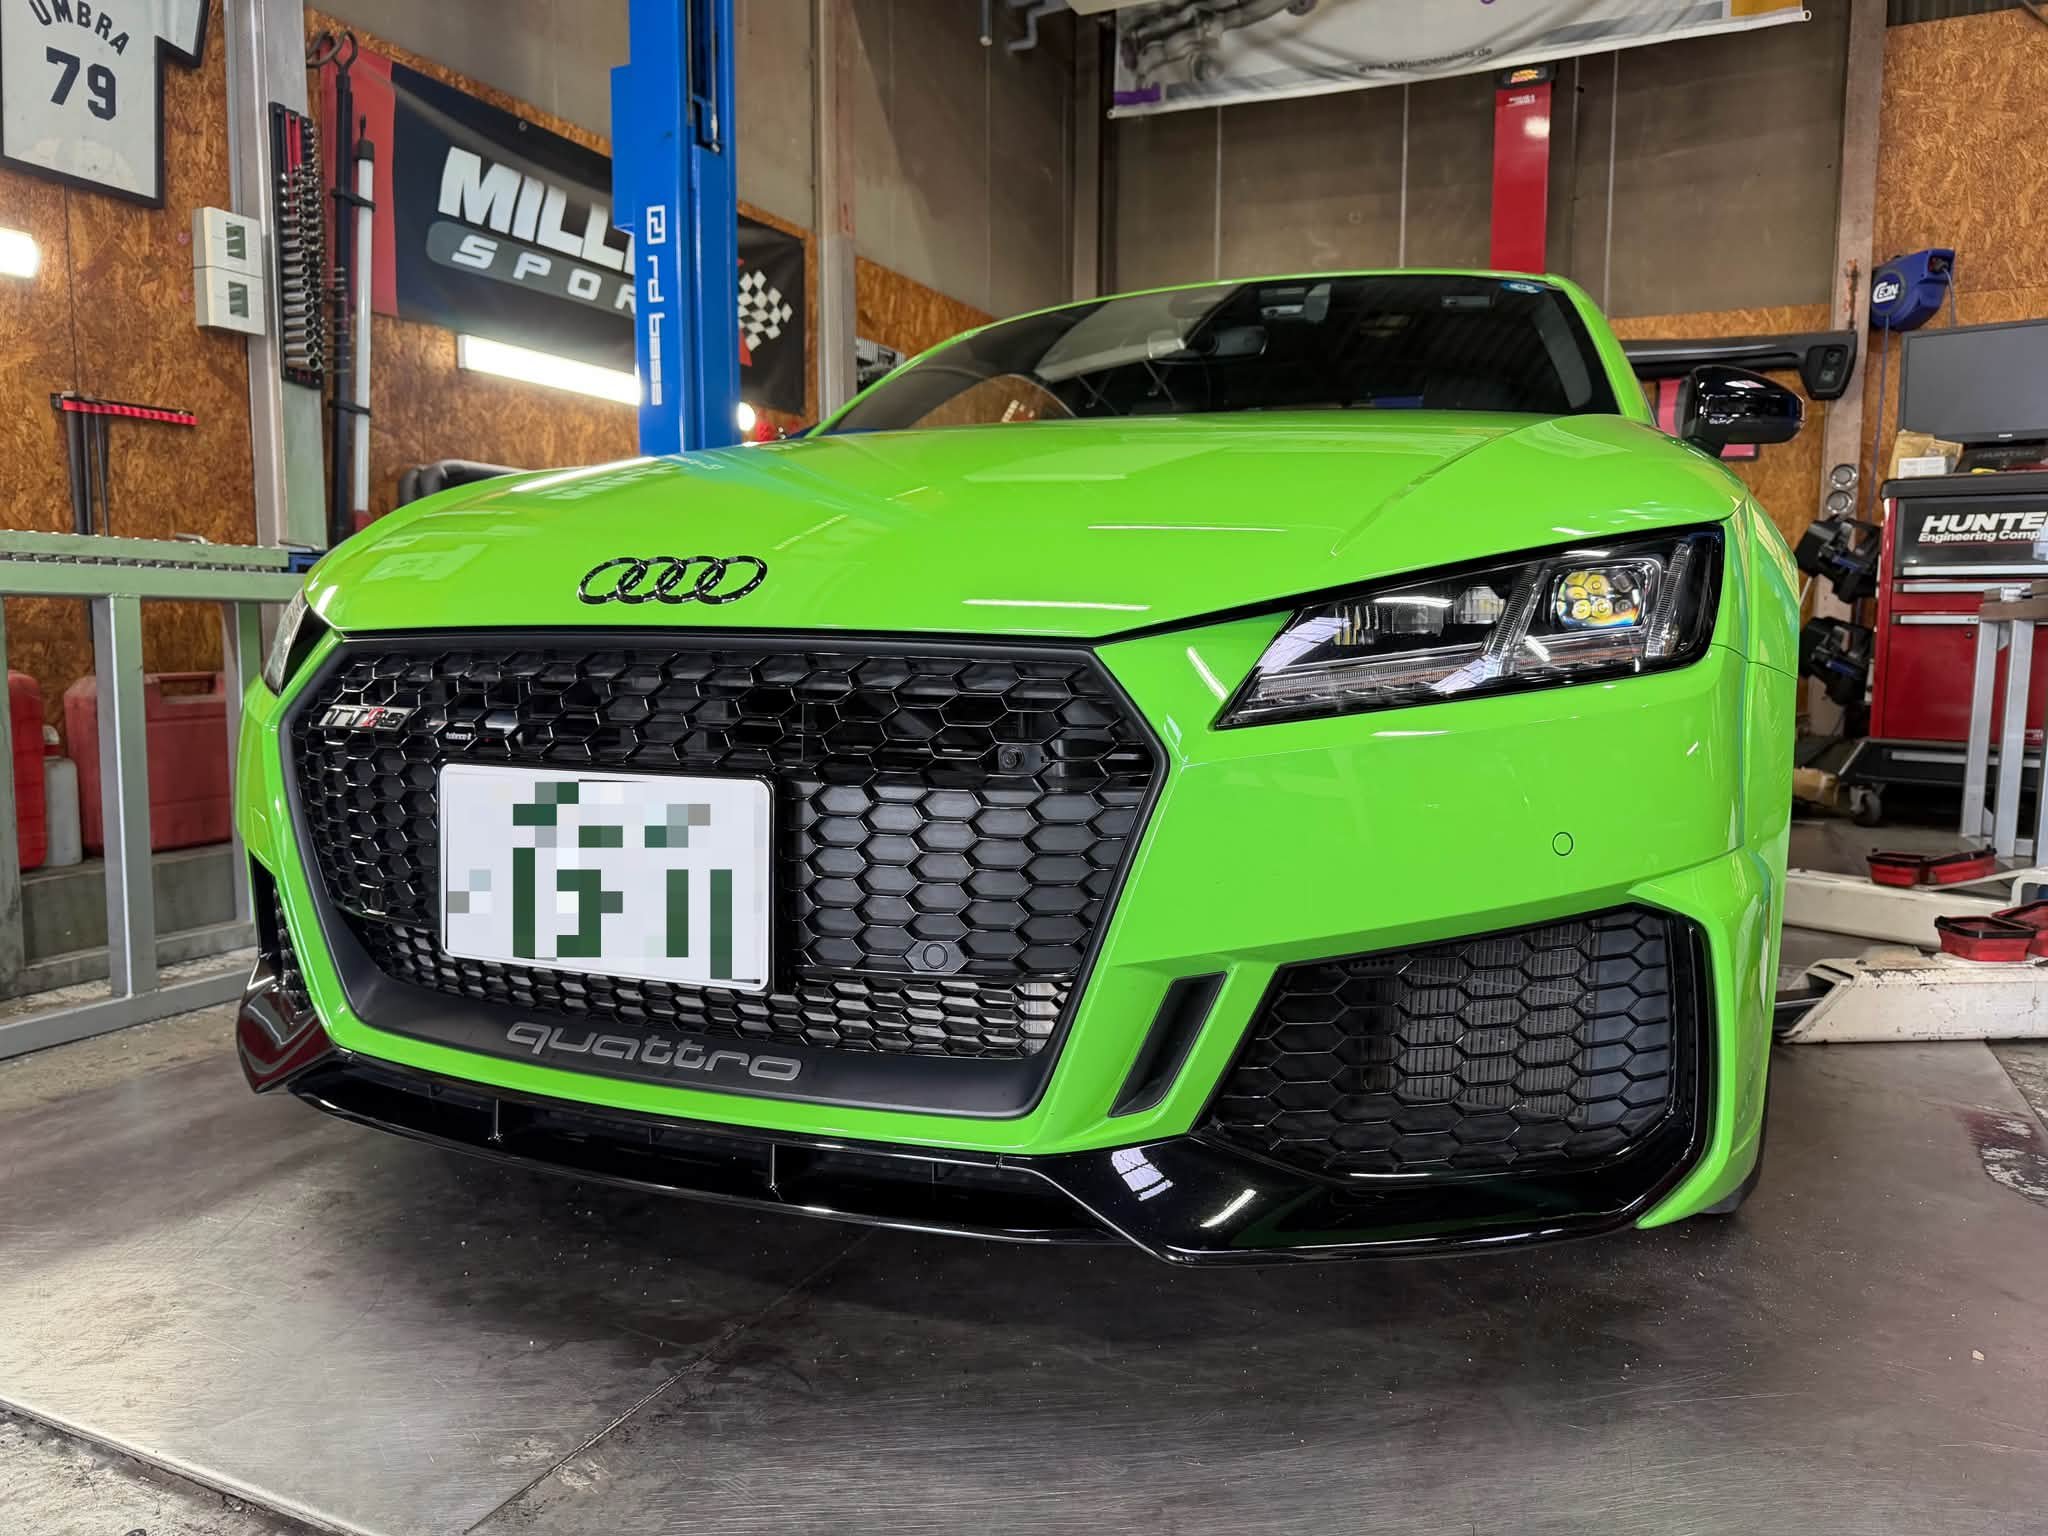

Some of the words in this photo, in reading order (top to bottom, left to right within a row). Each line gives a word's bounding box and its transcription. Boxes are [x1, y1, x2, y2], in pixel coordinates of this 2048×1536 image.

[46, 46, 116, 121] 79
[438, 146, 635, 275] MILL
[451, 234, 637, 315] SPOR
[1918, 532, 1998, 544] Engineering
[1999, 530, 2041, 542] Comp
[1921, 511, 2048, 534] HUNTE
[506, 1021, 802, 1081] quattro
